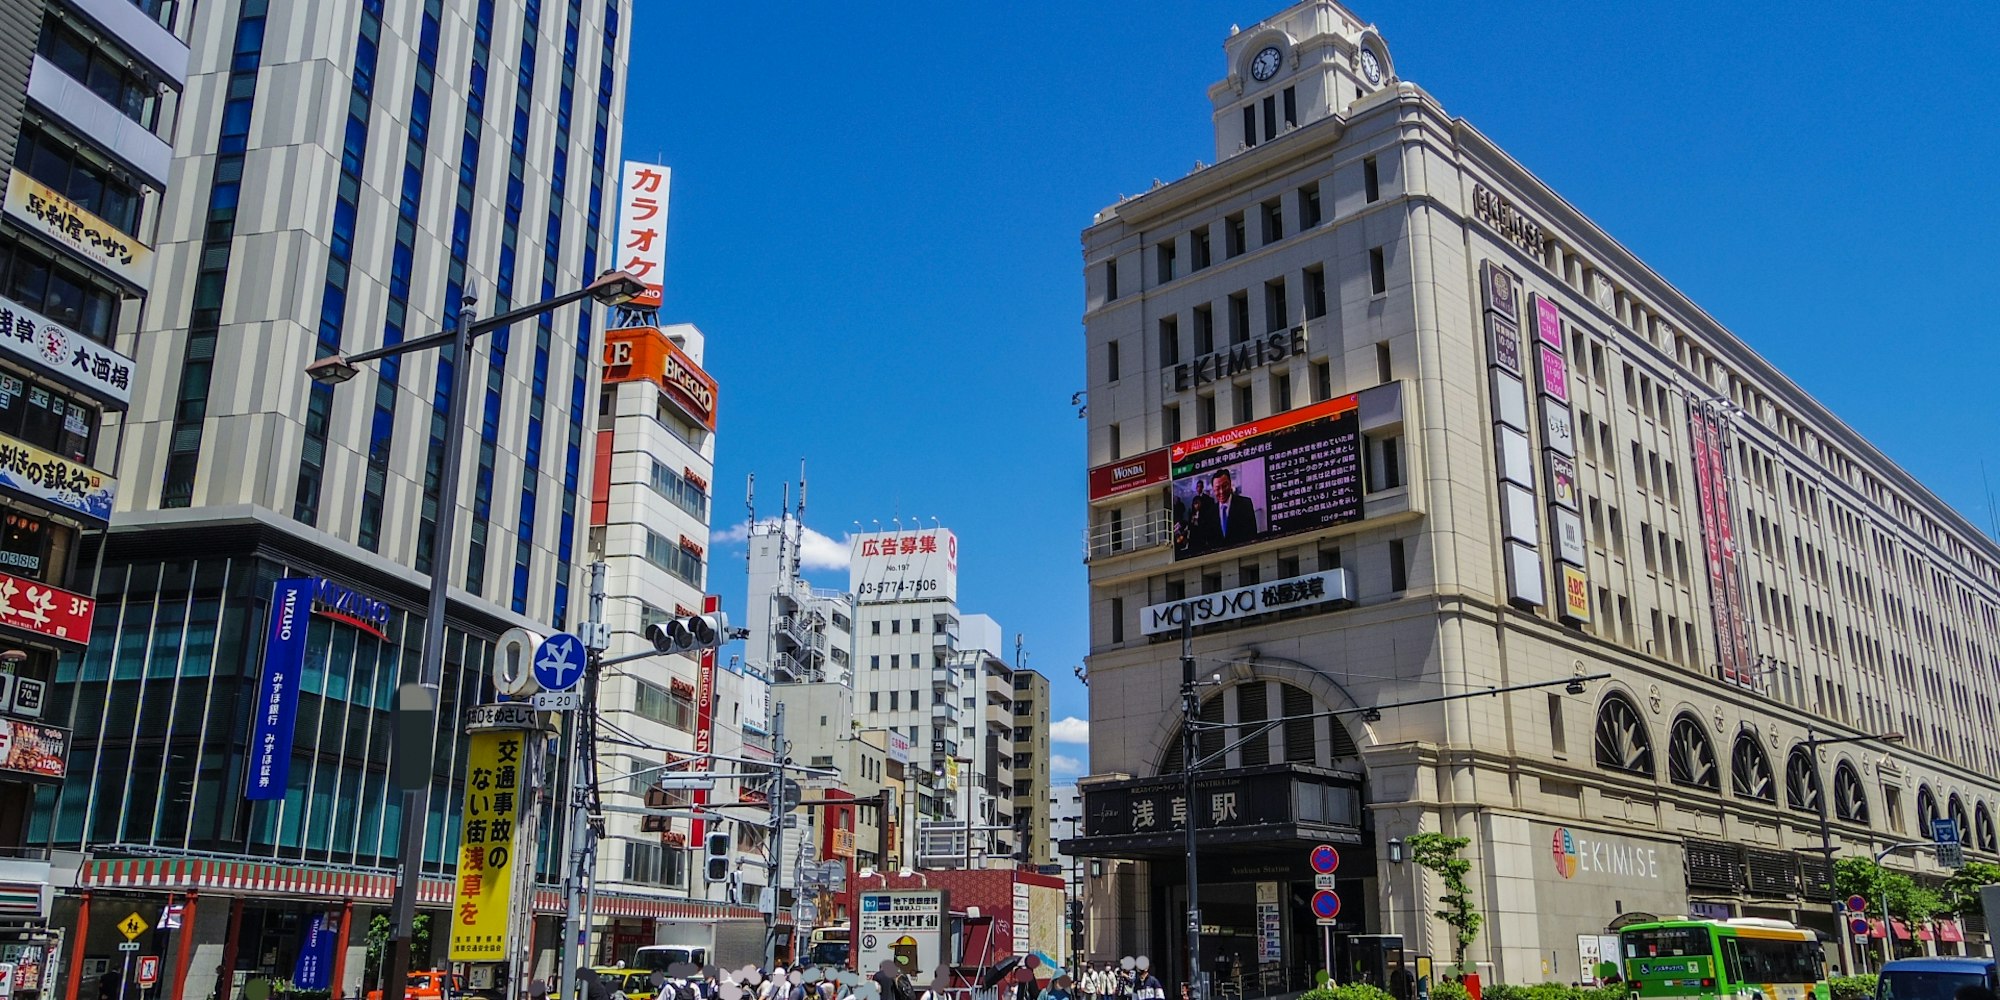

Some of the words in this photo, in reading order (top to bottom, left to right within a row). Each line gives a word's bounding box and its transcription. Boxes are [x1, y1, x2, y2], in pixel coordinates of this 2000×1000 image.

[625, 169, 662, 278] カラオケ
[72, 346, 129, 390] 大酒場
[1174, 325, 1307, 392] EKIMISE
[1204, 427, 1258, 447] PhotoNews
[1113, 465, 1143, 481] WONDA
[1553, 457, 1574, 478] Seria
[861, 536, 937, 557] 広告募集
[312, 576, 390, 625] MIZUHO
[859, 579, 937, 594] 03-5774-7506
[1261, 576, 1325, 608] 松屋浅草
[1567, 575, 1584, 597] ABC
[1568, 595, 1586, 611] MART
[68, 597, 89, 617] 3F
[280, 589, 297, 641] MIZUHO
[267, 672, 283, 726] みずほ銀行
[539, 696, 571, 707] 8-20
[258, 733, 275, 788] みずほ証券
[488, 740, 518, 870] 交通事故の
[1132, 791, 1238, 828] 浅草駅
[459, 767, 492, 926] ない街浅草を
[1578, 840, 1658, 878] EKIMISE
[1263, 865, 1290, 873] Station
